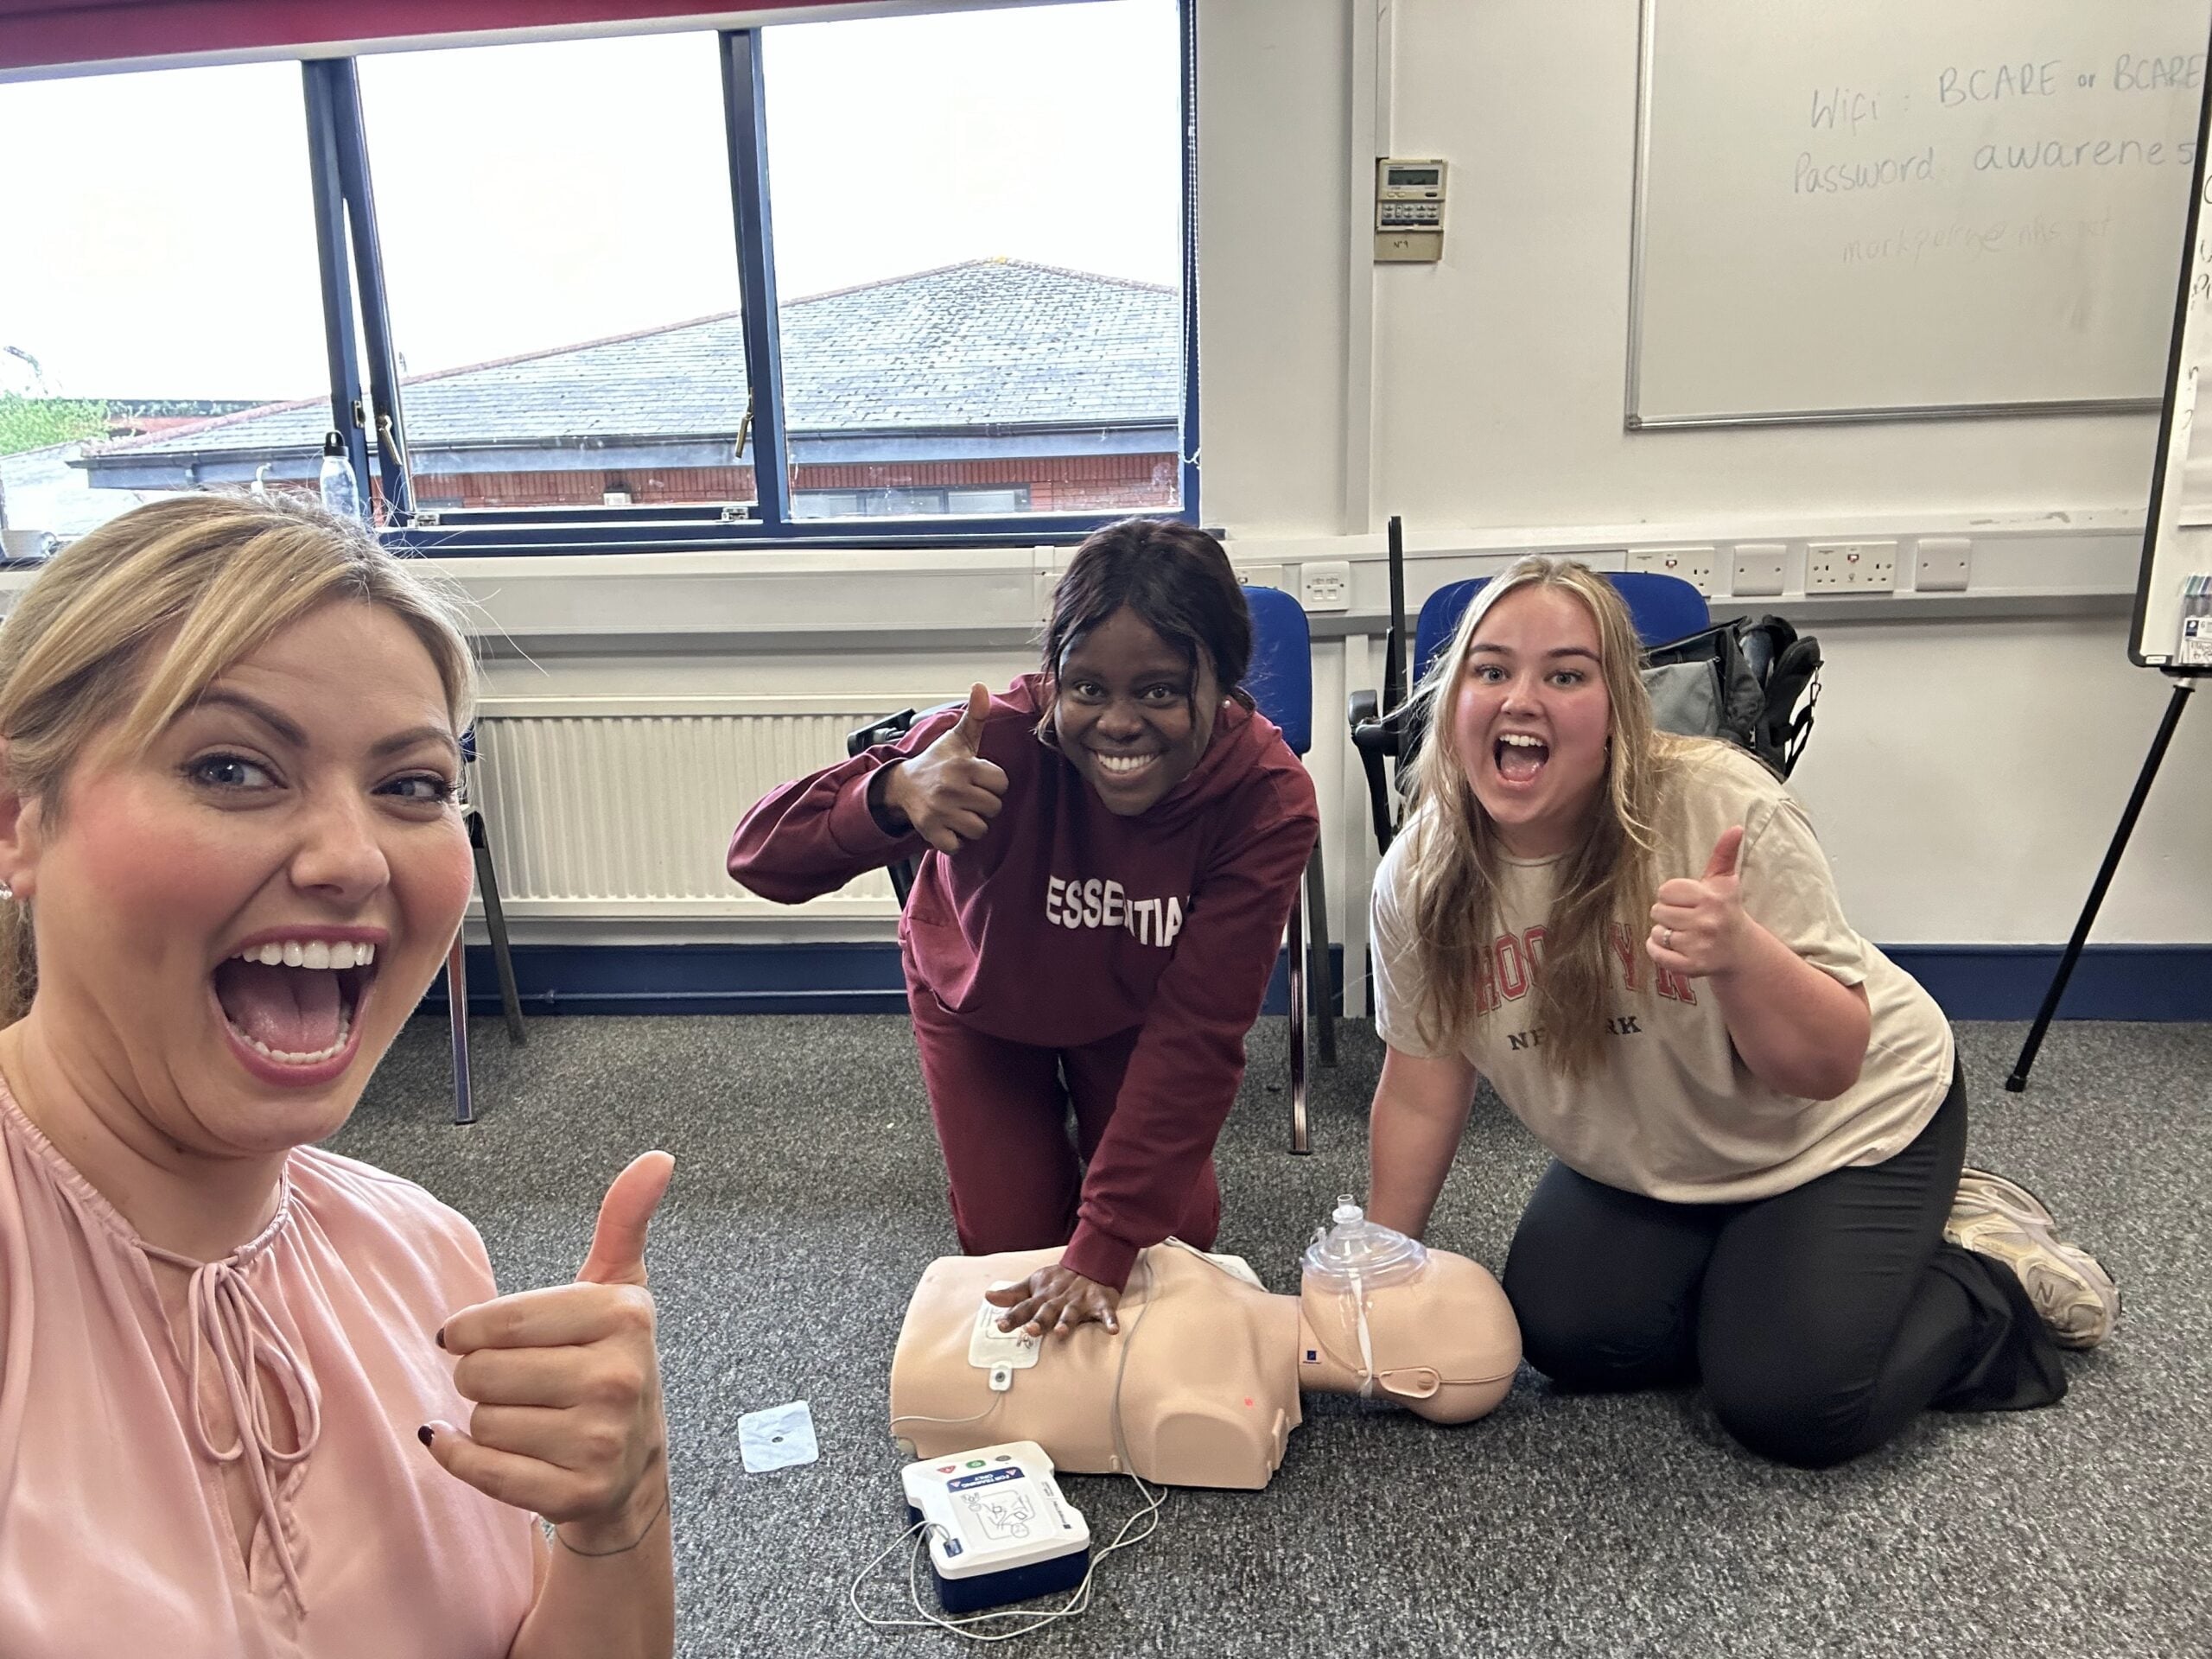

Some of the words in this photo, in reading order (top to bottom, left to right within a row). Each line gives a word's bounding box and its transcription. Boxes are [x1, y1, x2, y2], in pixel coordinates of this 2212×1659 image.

[1811, 87, 1878, 137] Wifi
[1939, 59, 2063, 108] BCARE
[2077, 73, 2095, 88] or
[1795, 146, 1935, 194] Password
[1046, 874, 1185, 948] ESSENTIA
